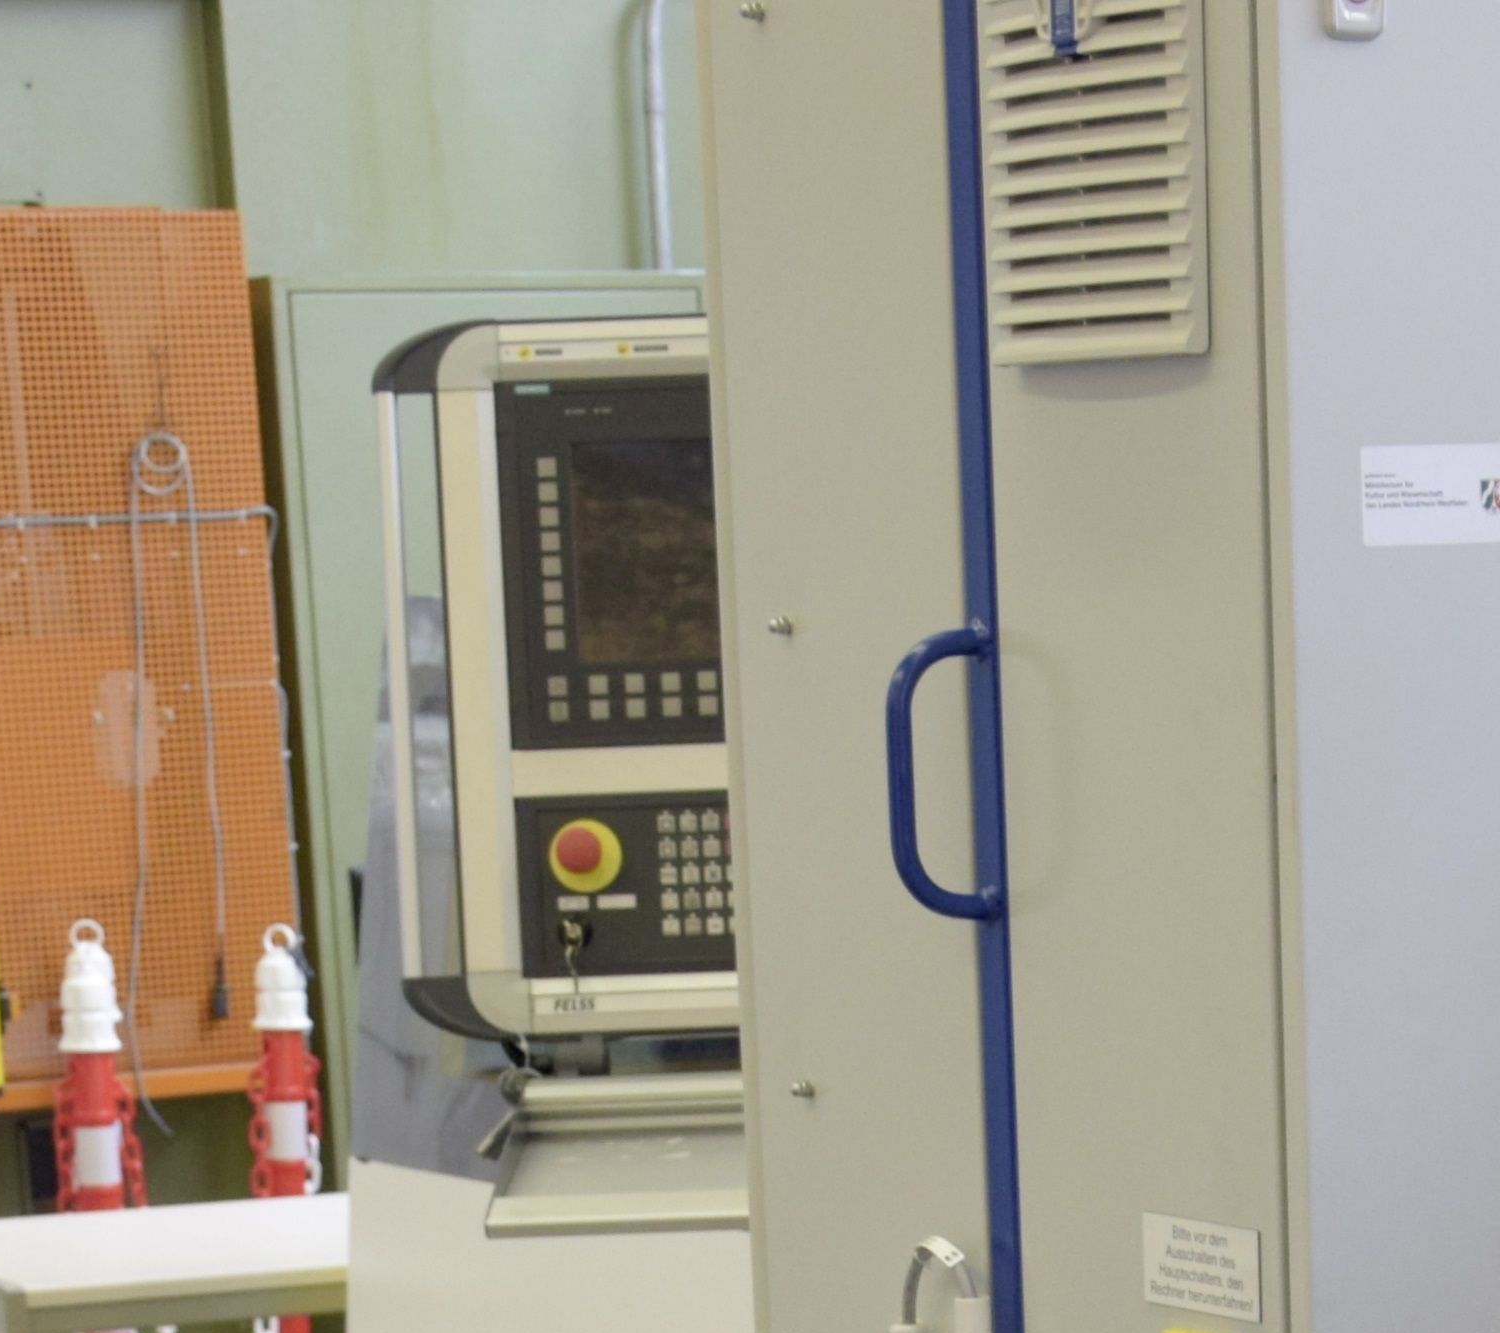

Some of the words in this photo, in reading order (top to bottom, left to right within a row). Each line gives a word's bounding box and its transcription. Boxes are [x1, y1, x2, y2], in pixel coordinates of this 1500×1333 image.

[554, 998, 595, 1012] FELSS
[1172, 1225, 1191, 1241] Bitte
[1193, 1233, 1207, 1244] vor
[1209, 1233, 1228, 1247] dem
[1166, 1245, 1218, 1266] Ausschalten
[1220, 1256, 1235, 1269] des
[1150, 1280, 1185, 1299] Rechner
[1227, 1278, 1243, 1291] den
